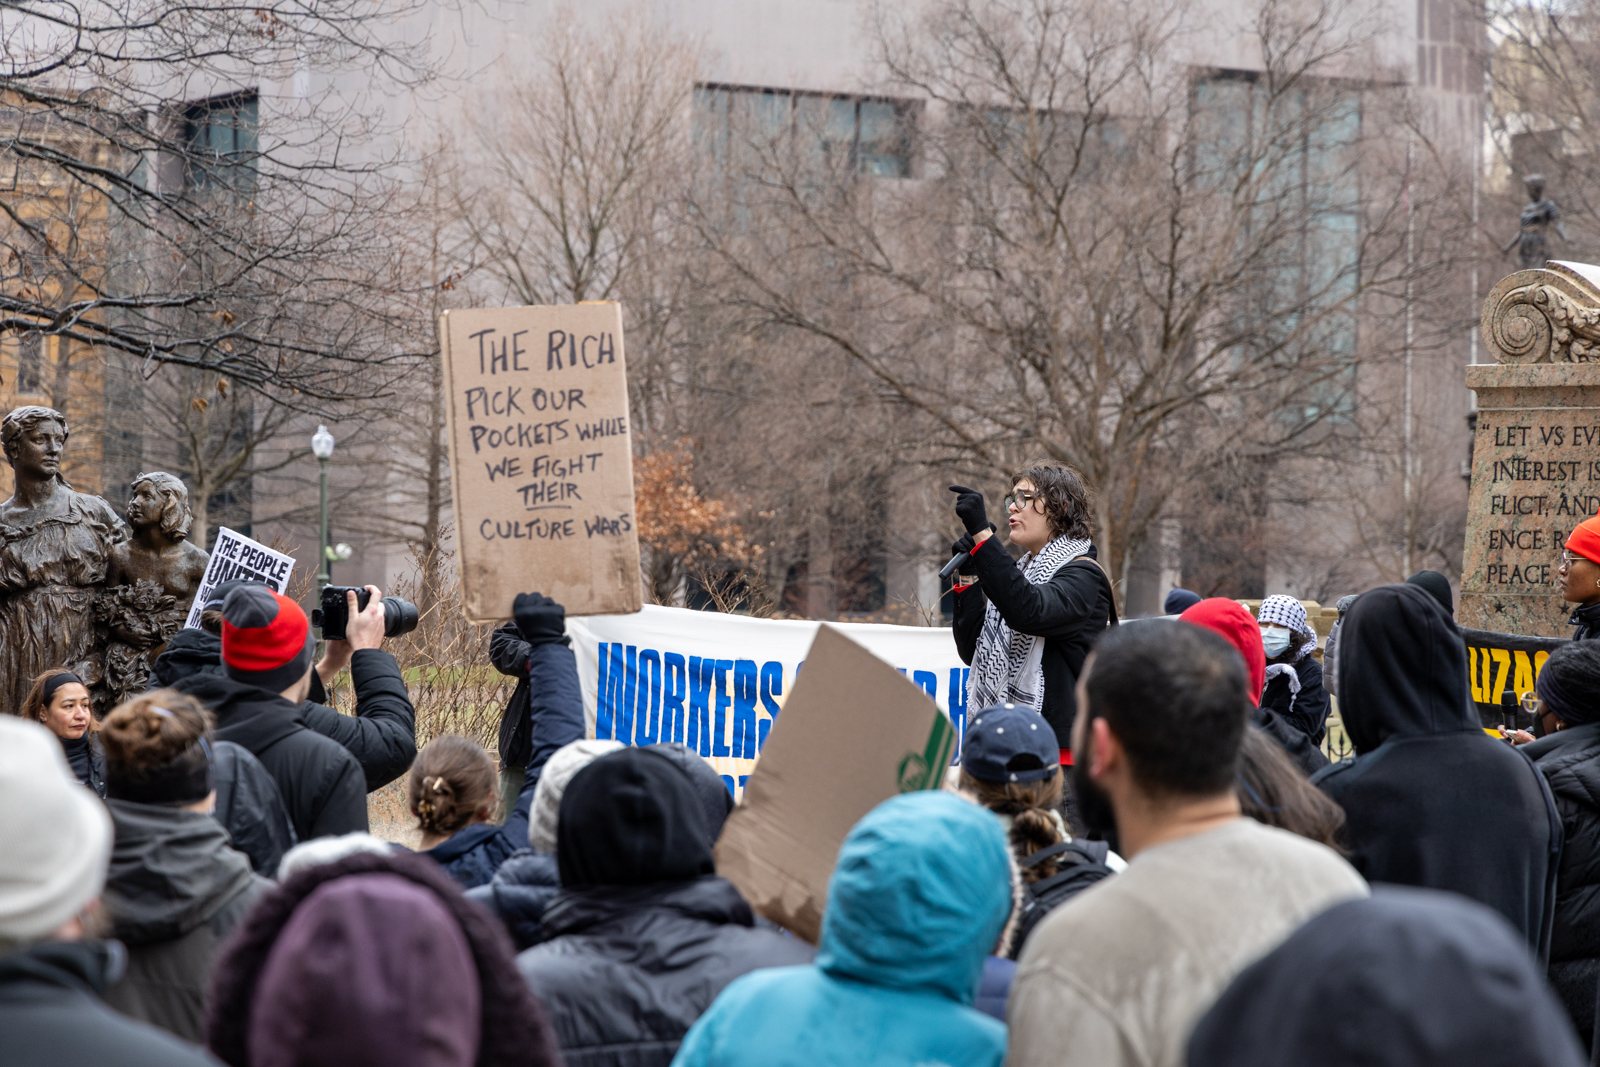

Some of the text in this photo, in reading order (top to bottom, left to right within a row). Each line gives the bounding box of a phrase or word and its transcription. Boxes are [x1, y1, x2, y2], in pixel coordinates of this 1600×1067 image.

[469, 328, 615, 375] THE RICH
[465, 386, 586, 421] PICK OUR
[470, 417, 627, 454] POCKETS WHILE
[1539, 426, 1565, 447] VS
[485, 453, 603, 482] WE FIGHT
[1493, 458, 1581, 483] INTEREST
[517, 480, 582, 505] THEIR
[480, 514, 632, 540] CULTURE WARS
[1488, 530, 1571, 550] ENCE R
[218, 535, 289, 582] THE PEOPLE
[596, 642, 783, 760] WORKERS
